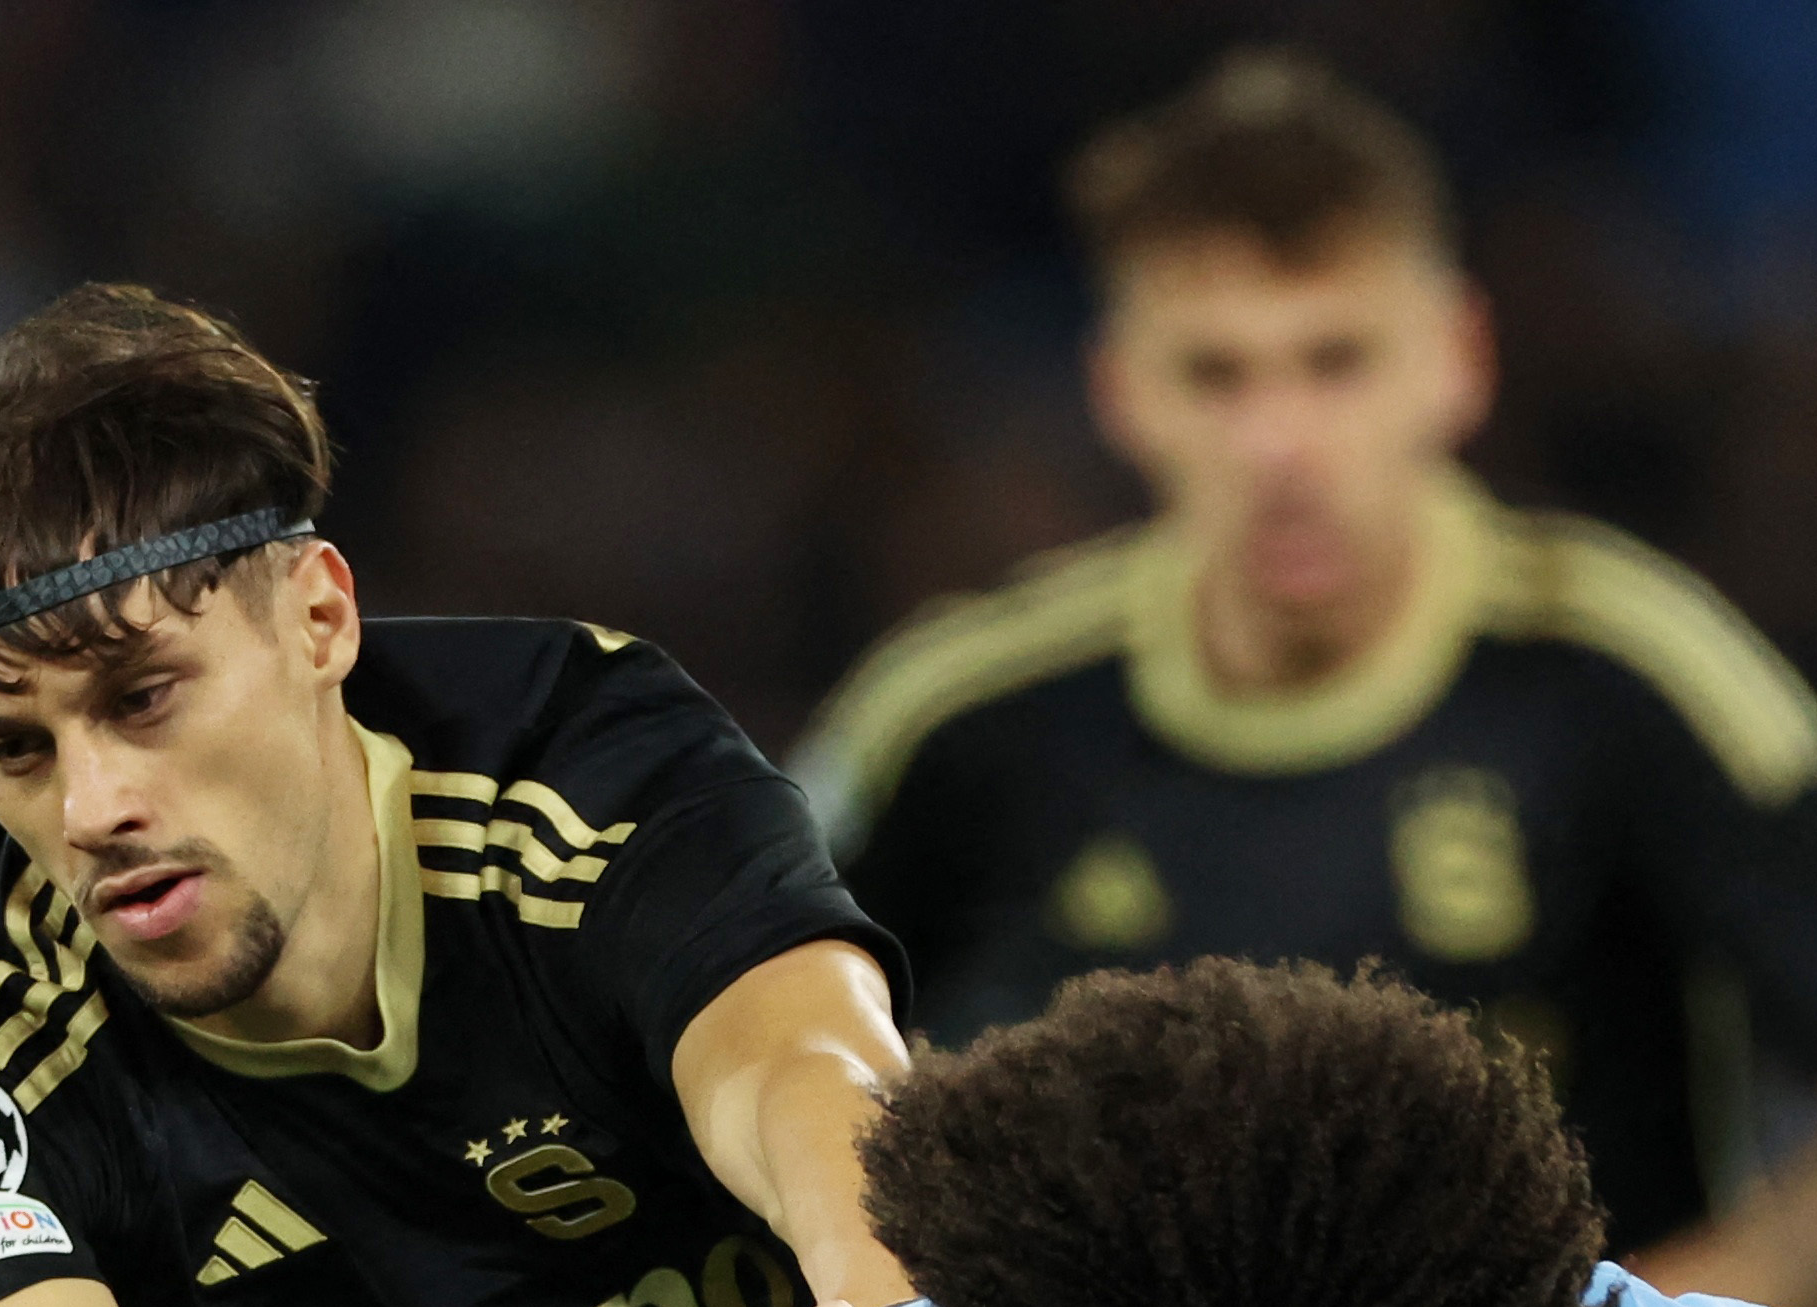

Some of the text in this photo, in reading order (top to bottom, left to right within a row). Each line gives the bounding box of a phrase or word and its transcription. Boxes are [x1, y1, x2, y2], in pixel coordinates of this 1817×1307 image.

[484, 1142, 638, 1241] S
[0, 1235, 66, 1254] for children
